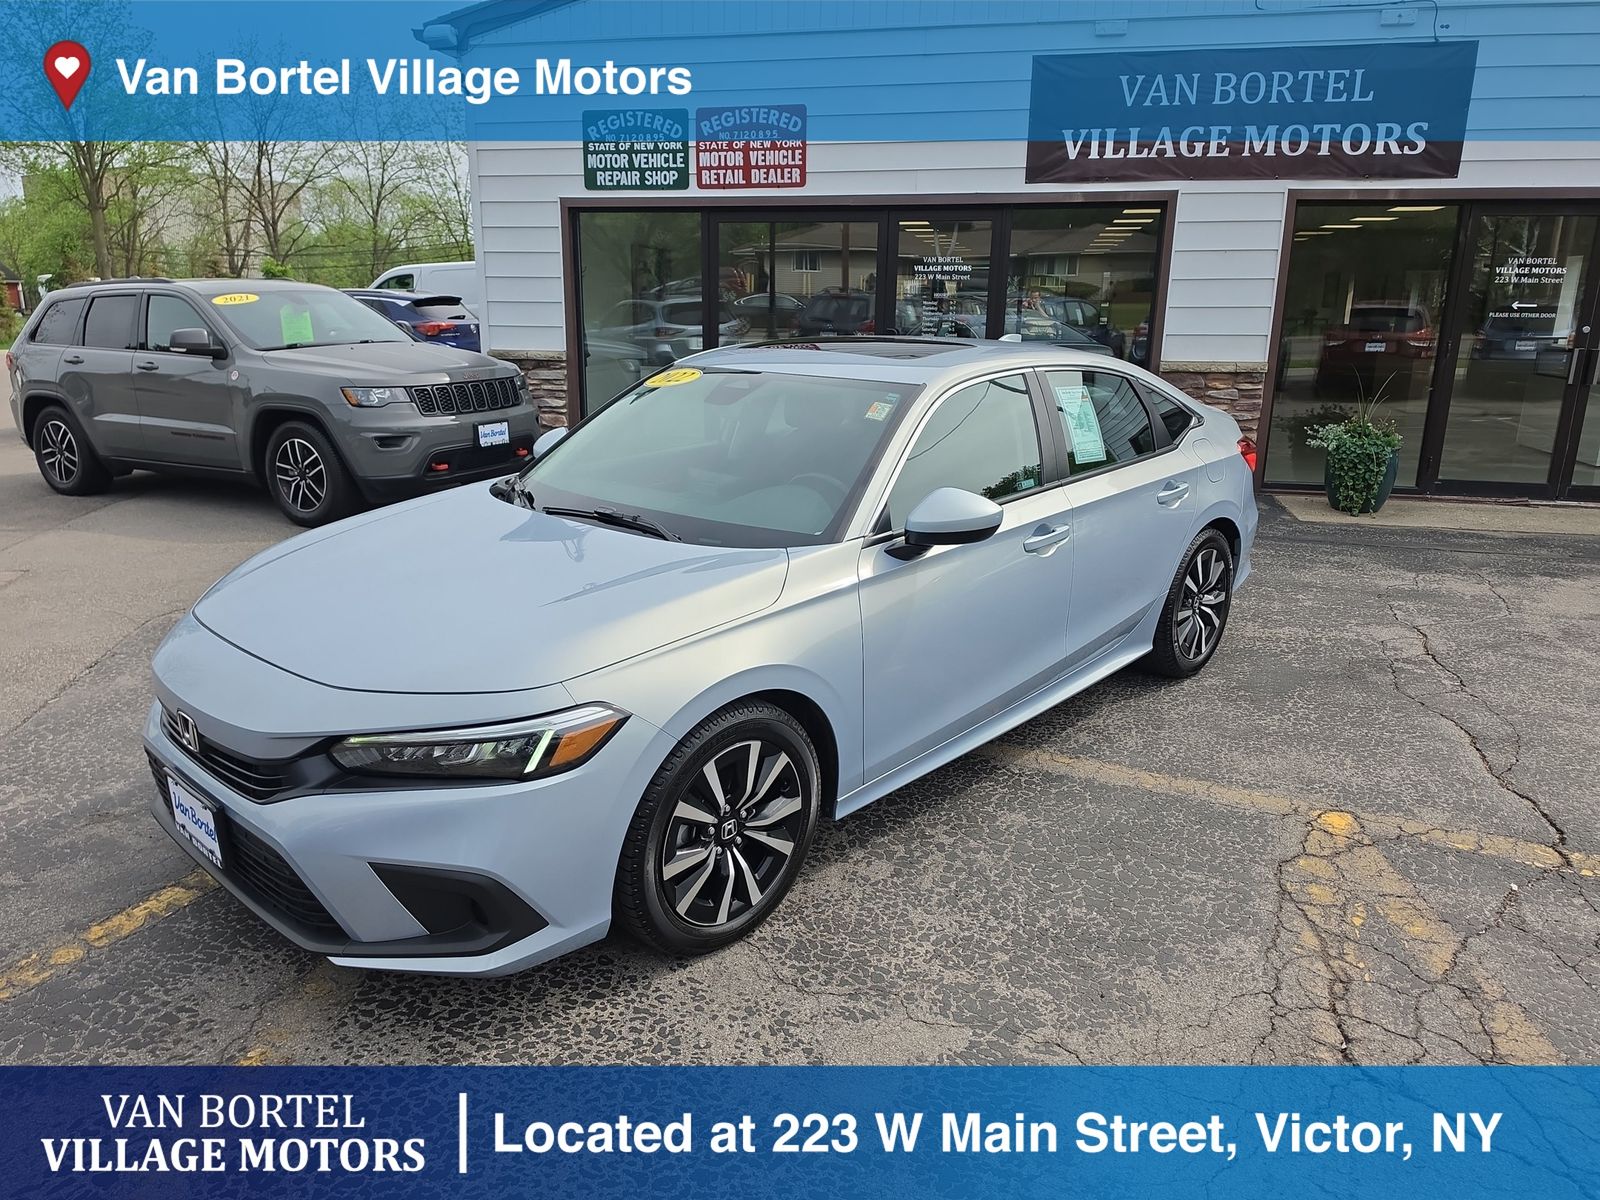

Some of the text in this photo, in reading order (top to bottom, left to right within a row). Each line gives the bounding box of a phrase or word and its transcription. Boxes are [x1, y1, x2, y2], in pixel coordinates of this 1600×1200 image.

[1119, 68, 1375, 107] VAN BORTEL
[587, 111, 683, 141] REGISTERED
[700, 107, 802, 136] REGISTERED
[733, 129, 779, 139] 7120895
[1061, 121, 1429, 160] VILLAGE MOTORS
[588, 141, 683, 151] STATE OF NEW YORK
[699, 139, 803, 150] STATE OF NEW YORK
[587, 153, 685, 169] MOTOR VEHICLE
[699, 149, 803, 167] MOTOR VEHICLE
[596, 170, 679, 186] REPAIR SHOP
[701, 168, 801, 185] RETAIL DEALER
[1508, 257, 1558, 265] VAN BORTEL
[1495, 266, 1567, 274] VILLAGE MOTORS
[1540, 276, 1564, 284] Street
[223, 294, 250, 304] 2021
[173, 792, 217, 843] Van Bortel
